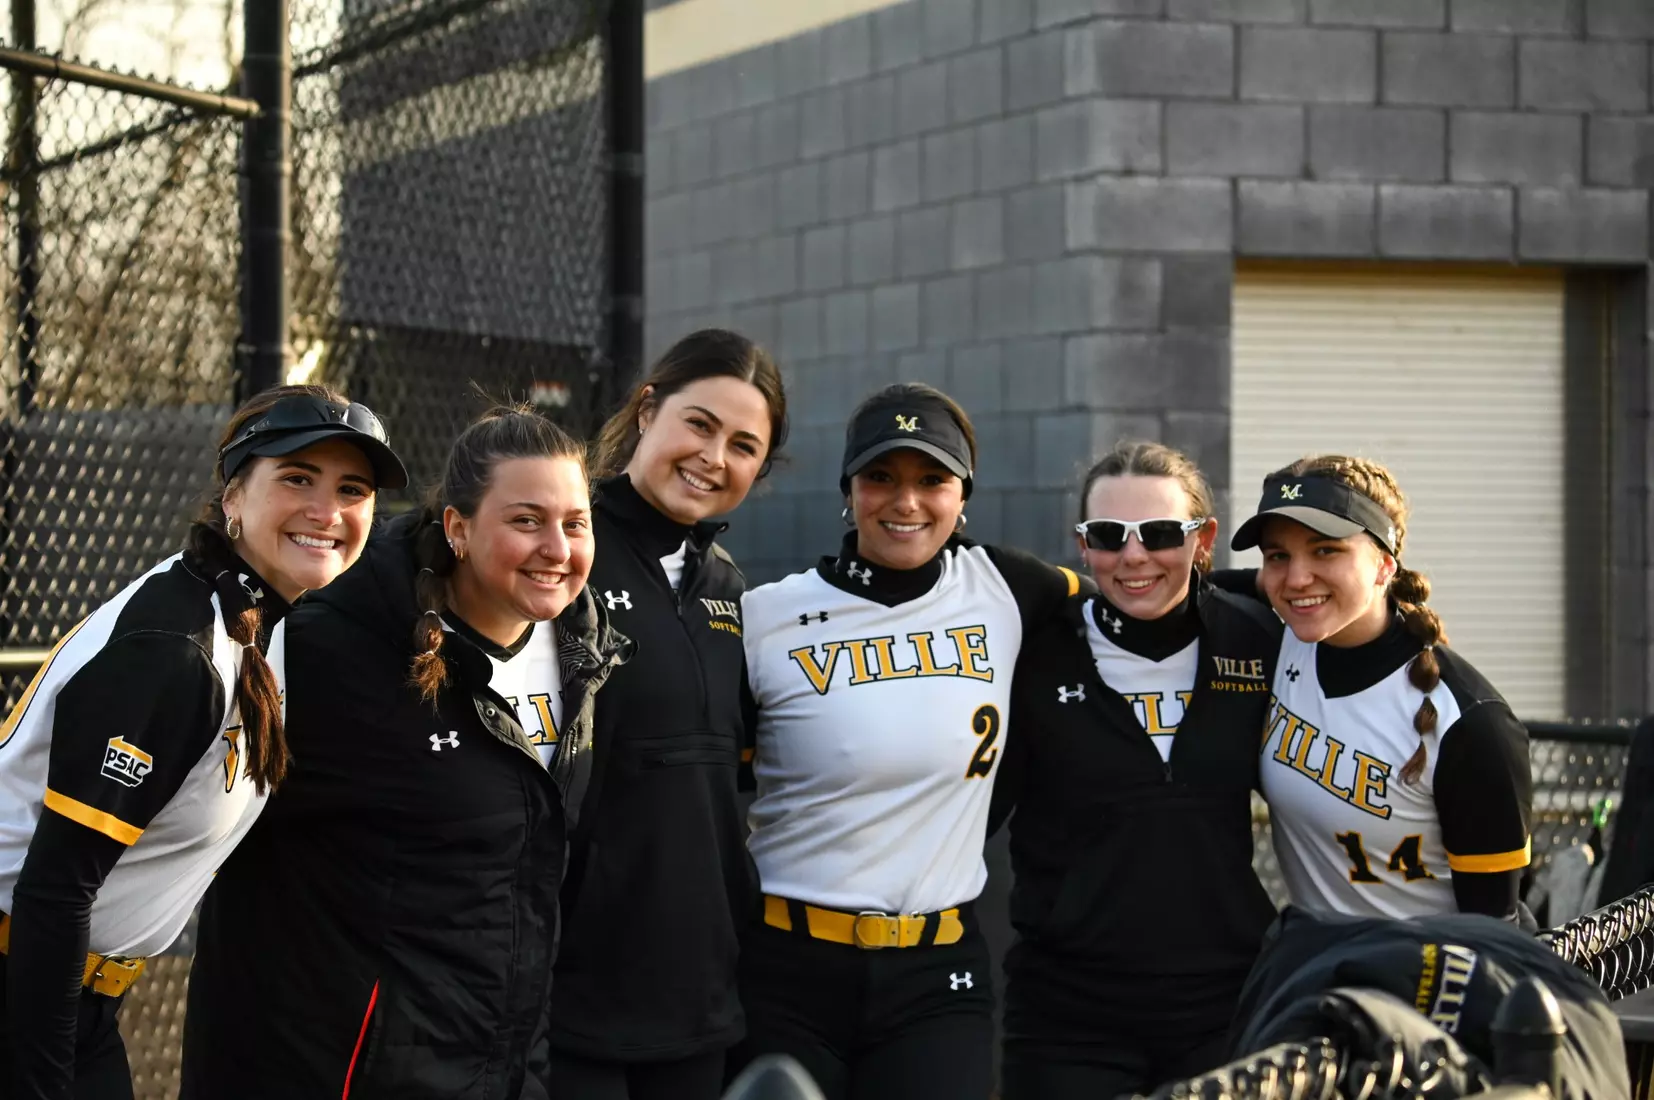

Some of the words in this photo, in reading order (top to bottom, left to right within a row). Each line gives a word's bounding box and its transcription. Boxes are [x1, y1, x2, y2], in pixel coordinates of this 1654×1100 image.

[788, 624, 994, 695] VILLE
[1212, 656, 1265, 679] VILLE
[1210, 680, 1268, 693] SOFTBALL
[105, 747, 149, 780] PSAC
[965, 703, 1000, 780] 2
[1260, 694, 1392, 820] VILLE
[1335, 831, 1438, 883] 14
